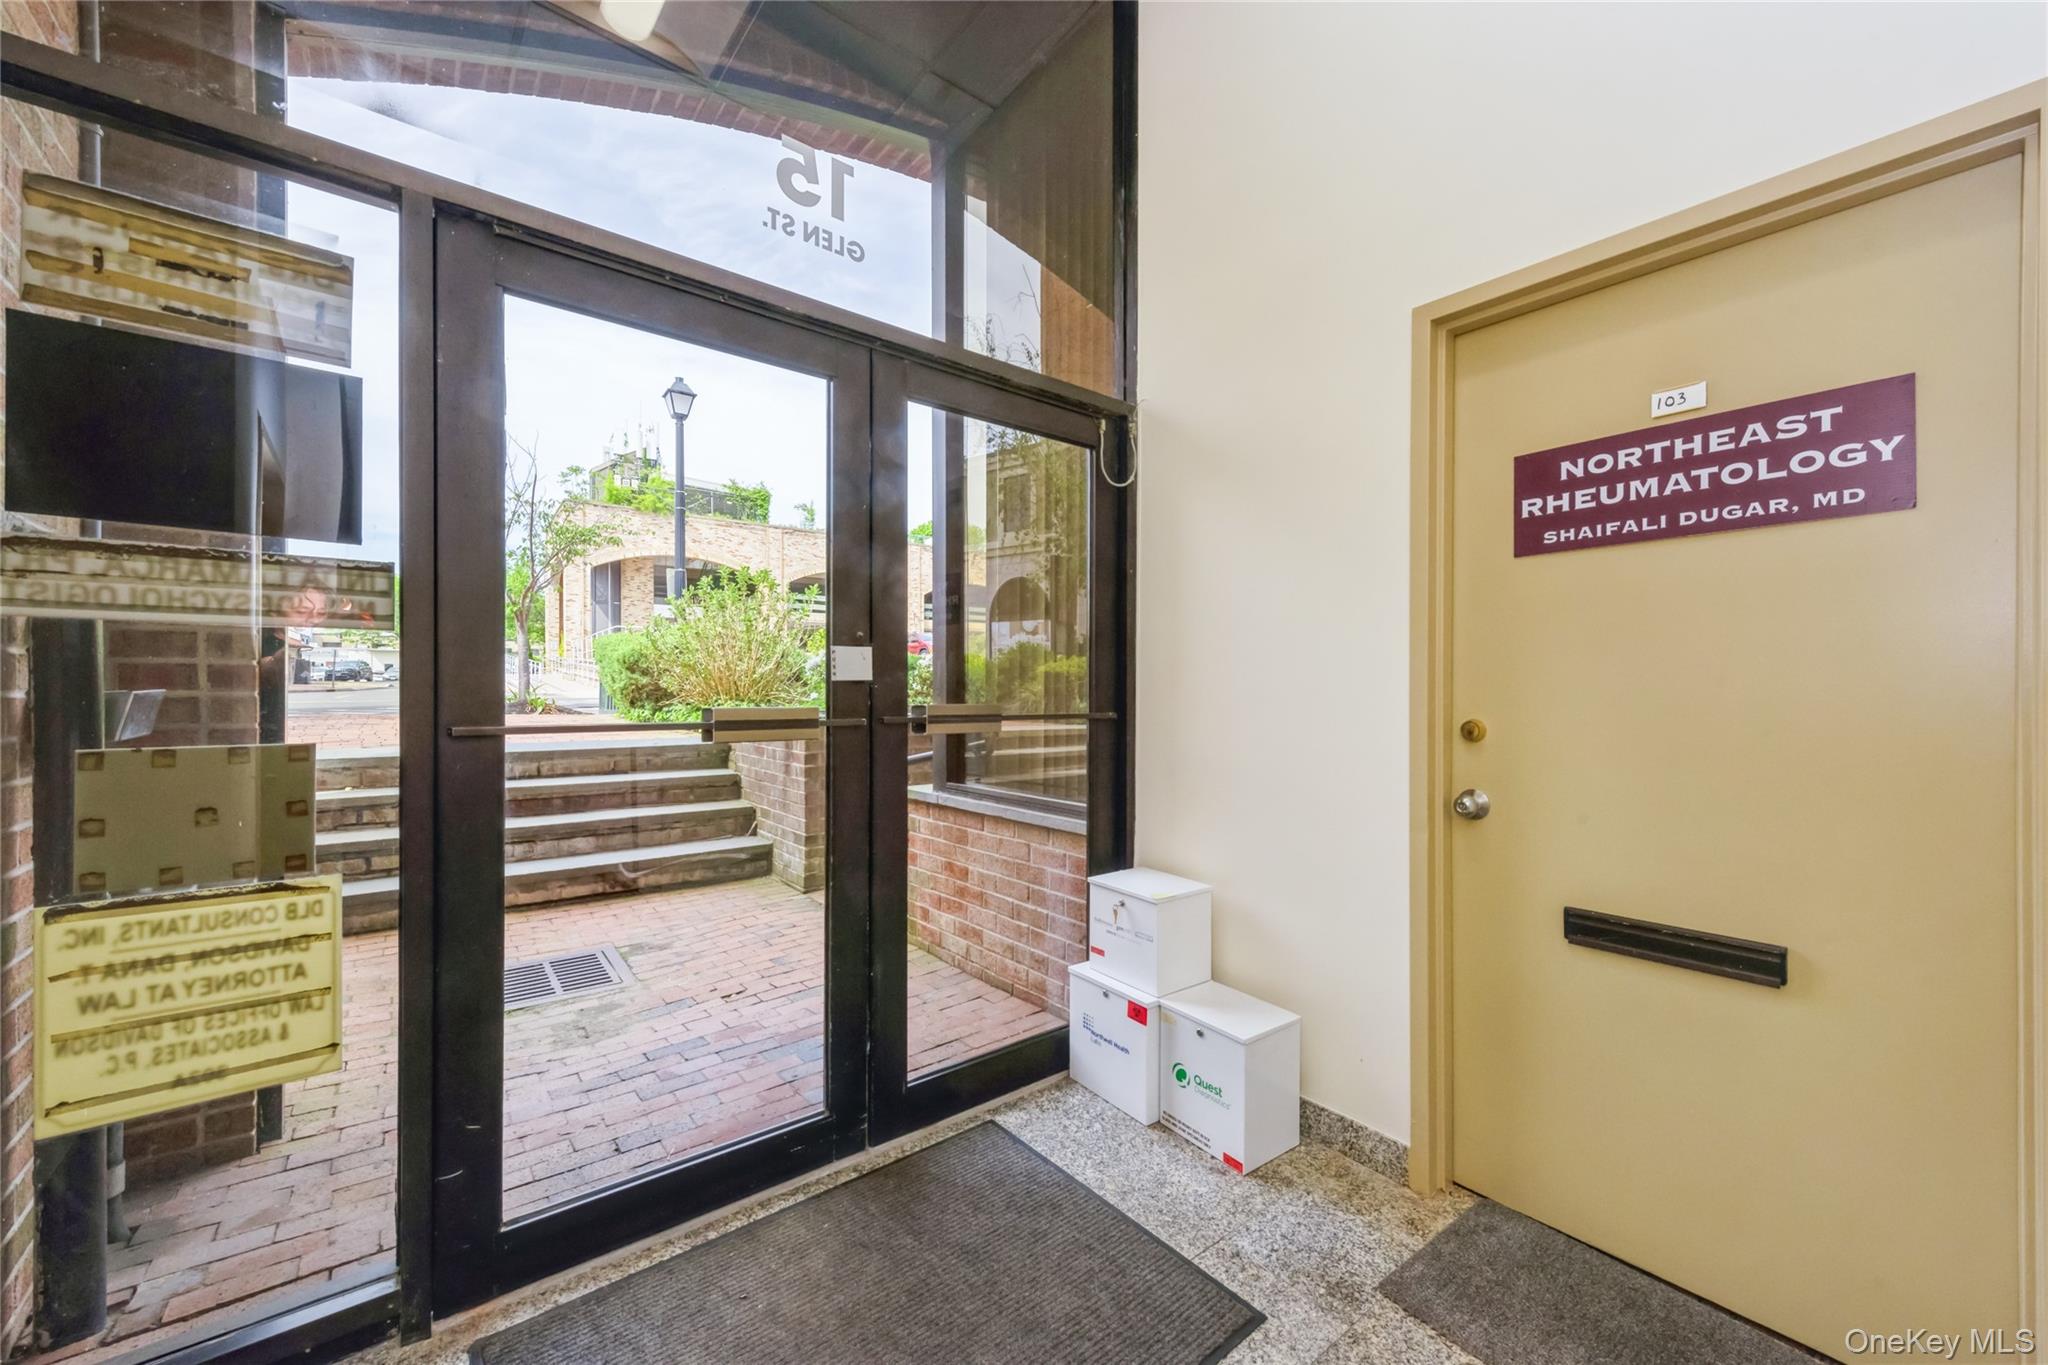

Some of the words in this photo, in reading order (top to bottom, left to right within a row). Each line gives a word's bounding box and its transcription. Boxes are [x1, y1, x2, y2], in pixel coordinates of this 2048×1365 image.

[1656, 392, 1687, 410] 103
[1560, 405, 1843, 480] NORTHEAST
[1521, 434, 1905, 519] RHEUMATOLOGY
[1543, 514, 1667, 544] SHAIFALI
[1679, 498, 1799, 527] DUGAR,
[1812, 488, 1866, 509] MD
[1194, 1074, 1223, 1098] Quest
